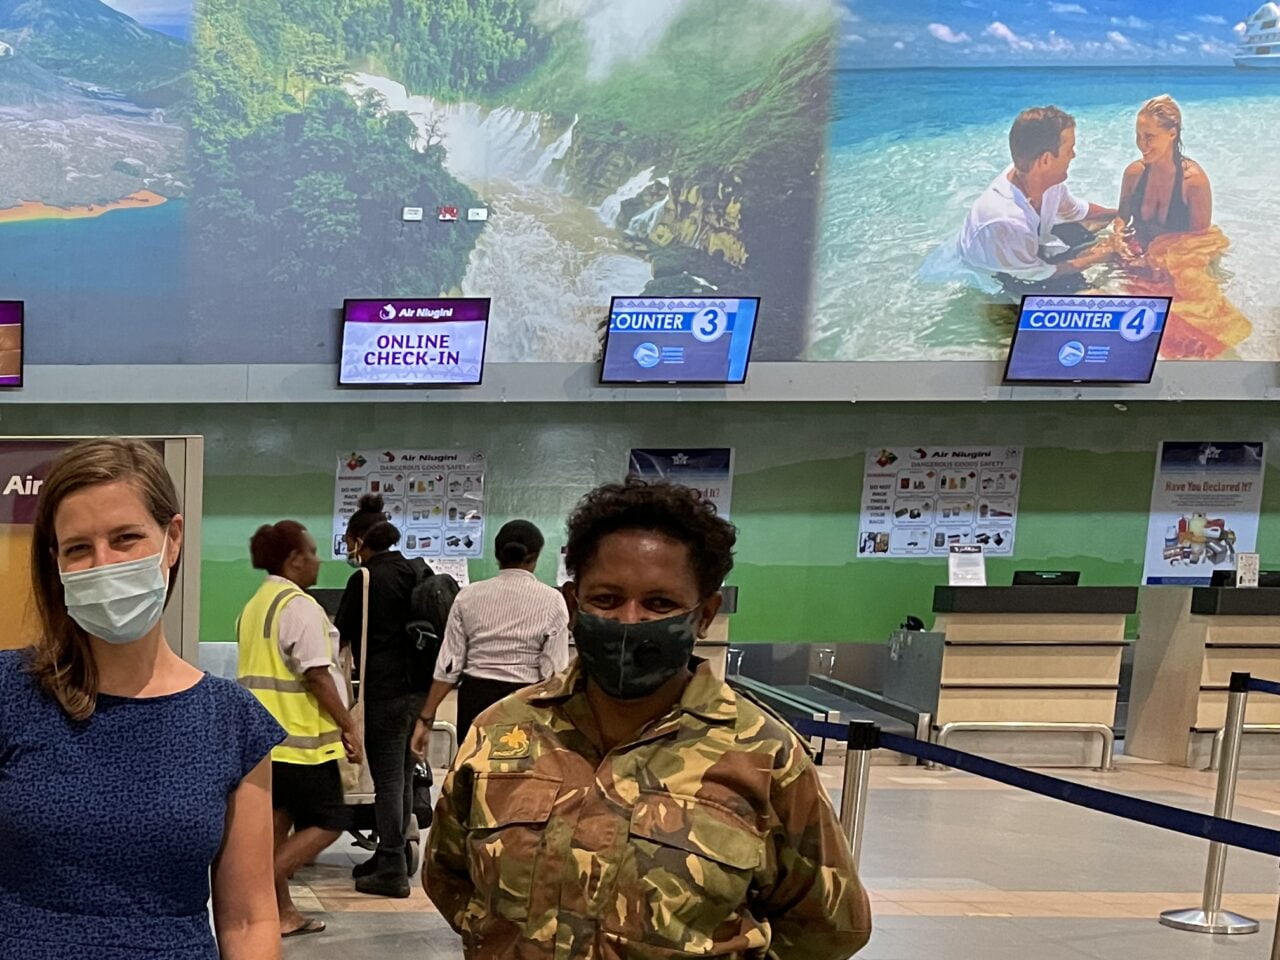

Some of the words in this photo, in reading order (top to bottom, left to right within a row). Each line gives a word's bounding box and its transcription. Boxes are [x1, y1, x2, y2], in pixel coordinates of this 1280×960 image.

[398, 308, 415, 318] Air
[416, 308, 453, 319] Niugini
[700, 309, 718, 336] 3
[1029, 311, 1113, 328] COUNTER
[1126, 309, 1146, 335] 4
[377, 334, 450, 349] ONLINE
[364, 351, 460, 366] CHECK-IN
[401, 454, 417, 462] Air
[418, 454, 458, 463] Niugini
[951, 451, 991, 459] Niugini
[2, 474, 44, 495] Air
[1165, 481, 1186, 492] Have
[1187, 481, 1201, 492] You
[1202, 481, 1241, 492] Declared
